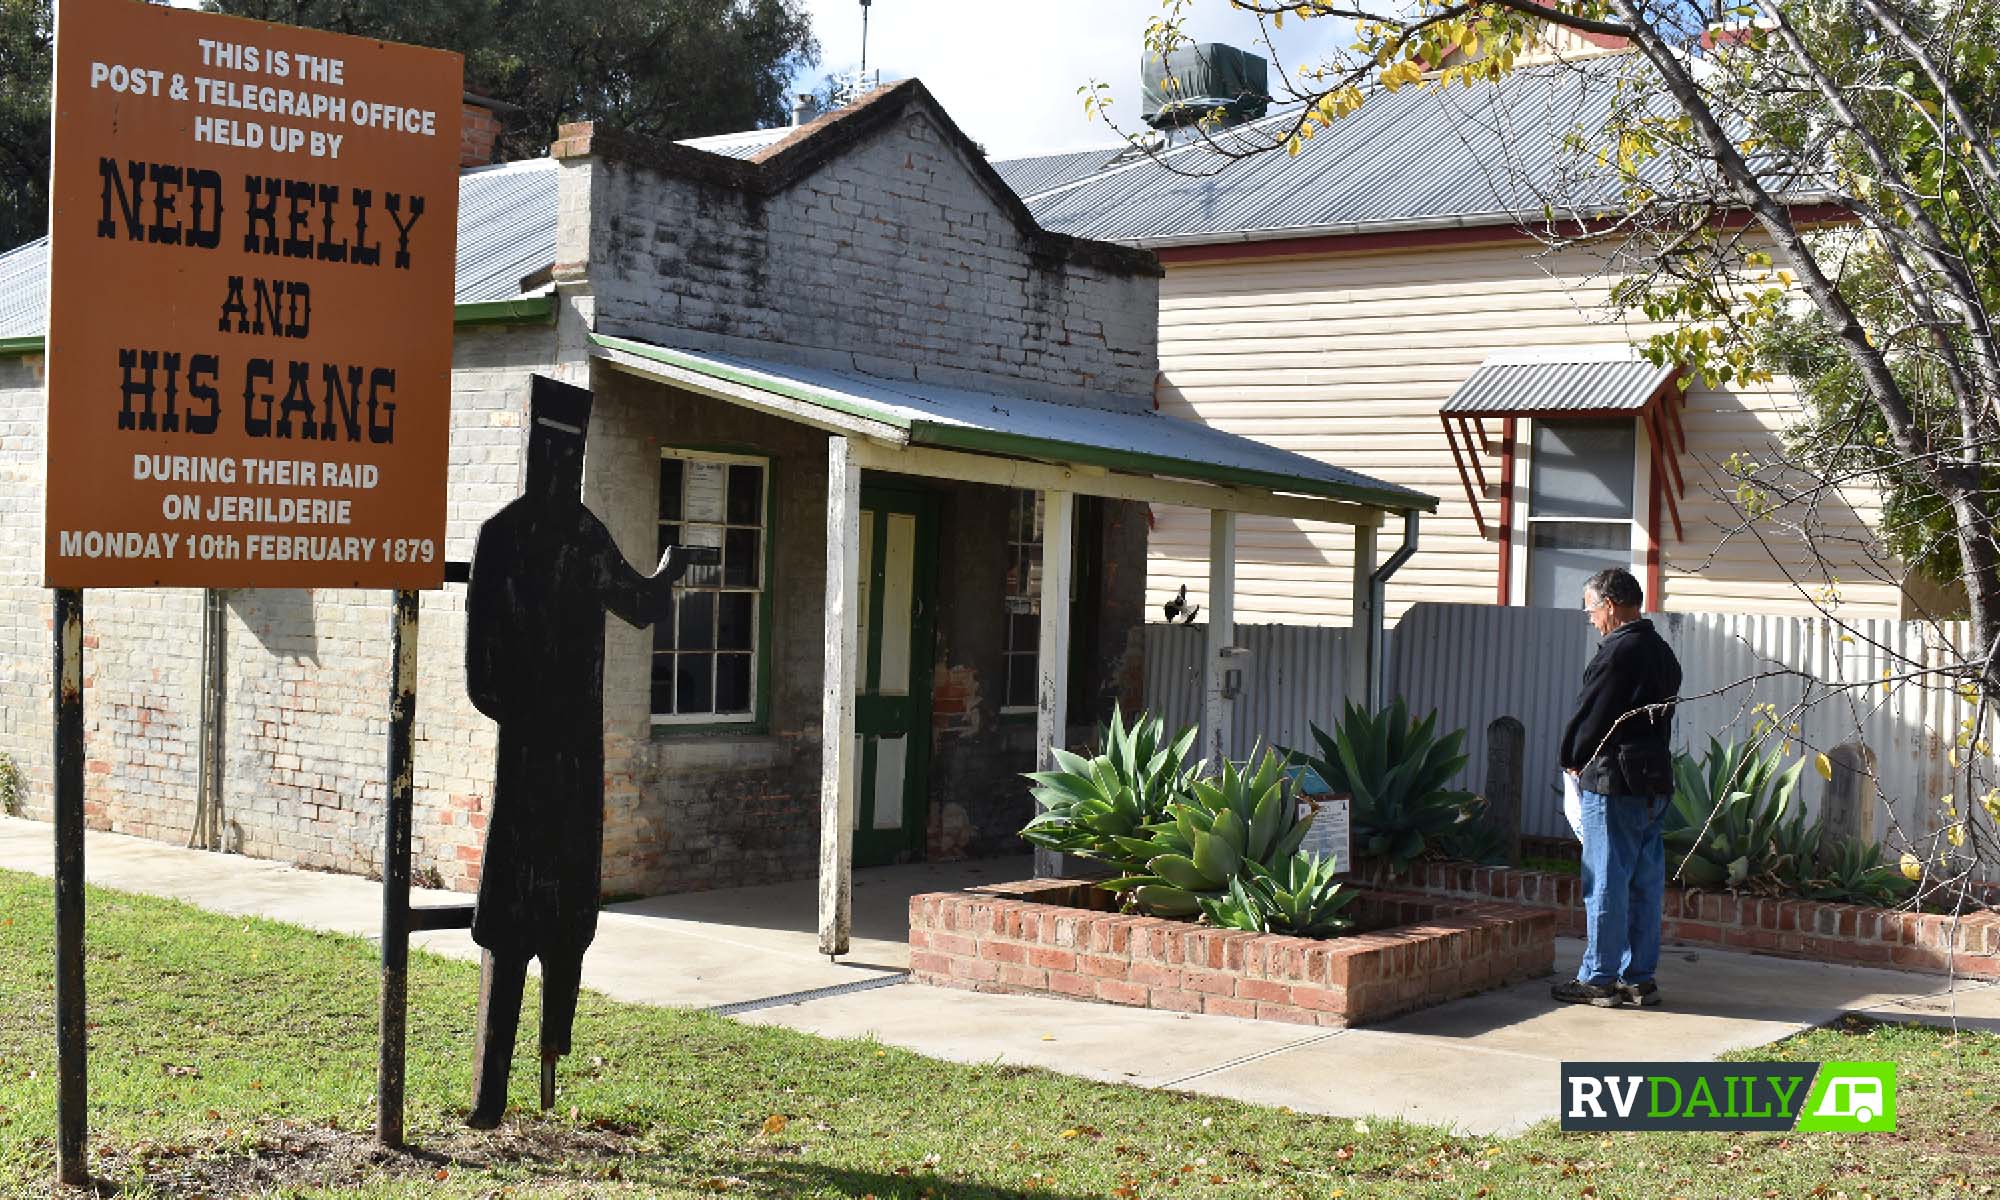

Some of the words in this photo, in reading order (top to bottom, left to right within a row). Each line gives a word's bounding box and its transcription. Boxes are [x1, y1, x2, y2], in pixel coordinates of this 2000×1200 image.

[199, 39, 259, 71] THIS
[266, 49, 289, 77] IS
[295, 54, 343, 85] THE
[91, 63, 163, 96] POST
[169, 74, 188, 100] &
[195, 77, 345, 122] TELEGRAPH
[351, 100, 435, 135] OFFICE
[195, 117, 263, 148] HELD
[271, 126, 304, 152] UP
[311, 131, 343, 158] BY
[98, 157, 223, 249] NED
[244, 176, 424, 269] KELLY
[219, 276, 311, 339] AND
[119, 349, 221, 434] HIS
[243, 359, 396, 444] GANG
[134, 455, 235, 483] DURING
[243, 459, 315, 486] THEIR
[323, 463, 377, 488] RAID
[163, 495, 200, 519] ON
[207, 497, 351, 523] JERILDERIE
[61, 531, 179, 558] MONDAY
[187, 535, 239, 558] 10th
[247, 535, 375, 560] FEBRUARY
[383, 539, 433, 562] 1879
